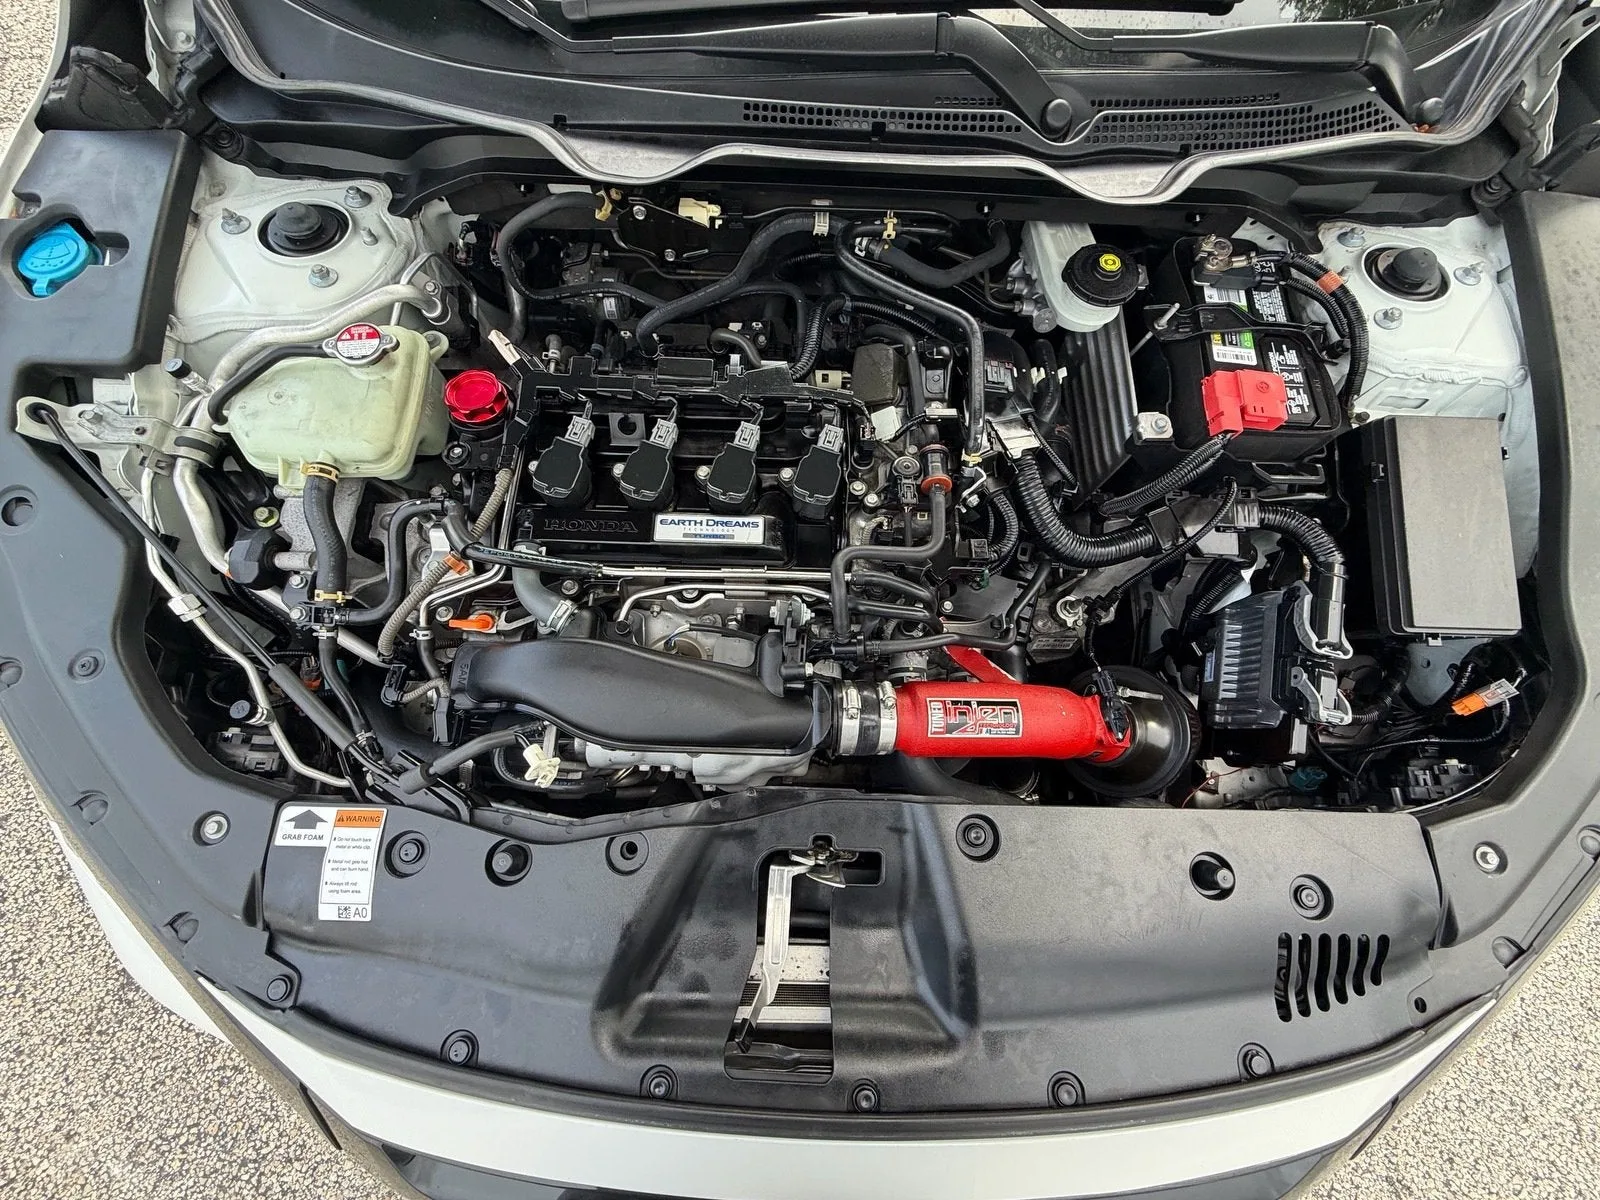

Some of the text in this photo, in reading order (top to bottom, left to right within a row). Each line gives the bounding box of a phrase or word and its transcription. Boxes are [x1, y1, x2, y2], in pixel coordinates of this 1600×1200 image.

[544, 519, 639, 534] HONDA
[659, 518, 760, 528] EARTH DREAMS
[930, 702, 944, 733] TUNED
[946, 700, 1018, 734] injen
[346, 815, 381, 823] WARNING
[281, 833, 324, 841] GRAB FOAM
[353, 907, 368, 919] A0
